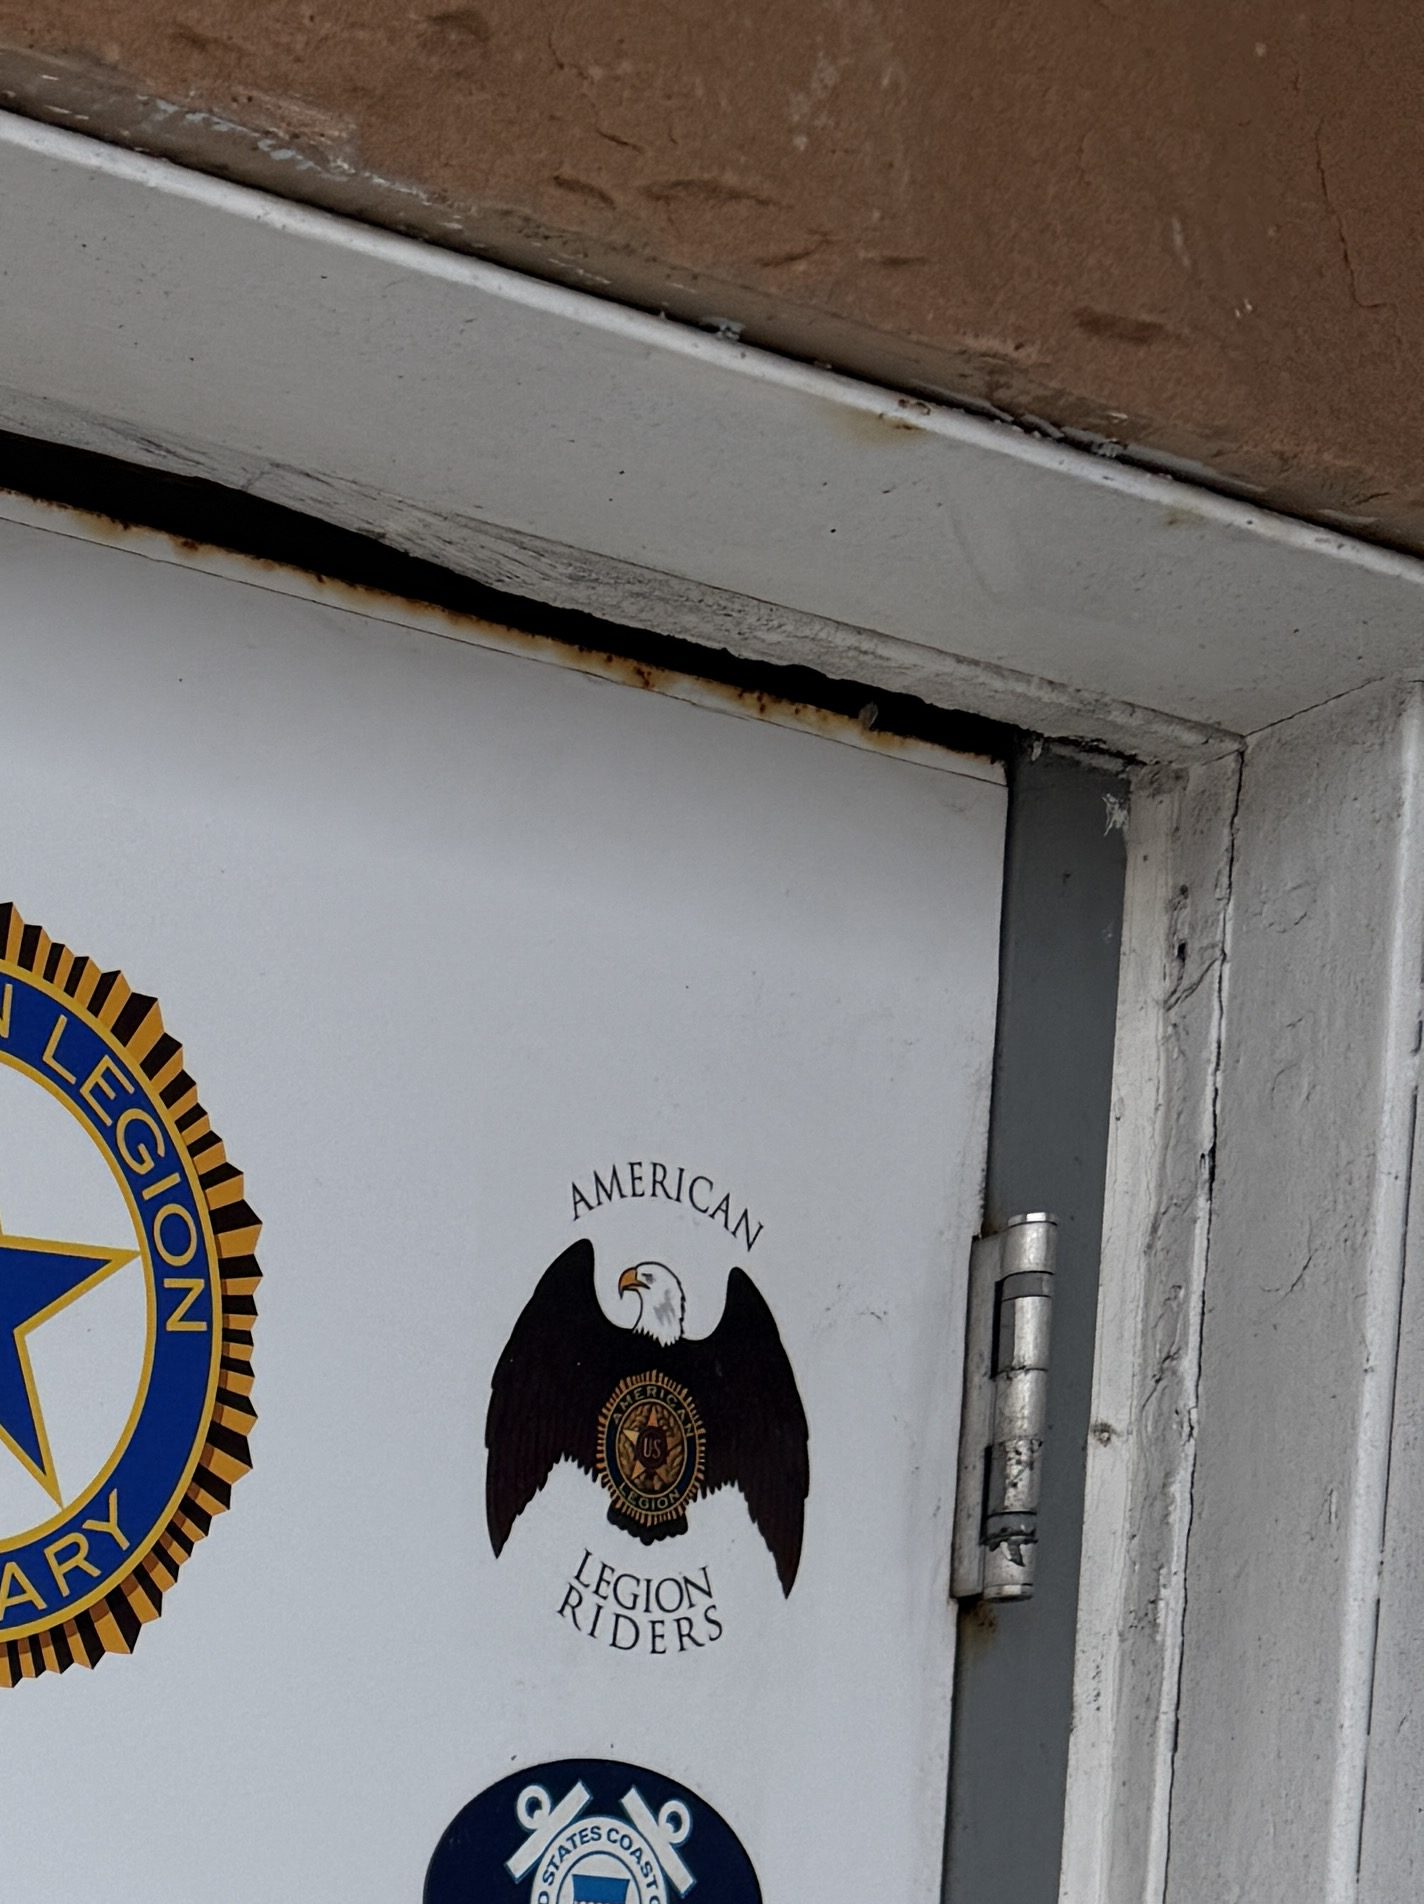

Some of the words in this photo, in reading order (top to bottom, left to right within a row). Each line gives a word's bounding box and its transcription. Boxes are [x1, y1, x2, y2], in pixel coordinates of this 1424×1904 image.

[41, 1016, 208, 1334] LEGION
[571, 1161, 763, 1253] AMERICAN
[613, 1385, 694, 1437] AMERICAN
[643, 1437, 661, 1459] US
[619, 1482, 681, 1510] LEGION
[574, 1548, 714, 1614] LEGION
[557, 1583, 723, 1655] RIDERS
[542, 1826, 602, 1886] STATES
[607, 1827, 658, 1890] COAST
